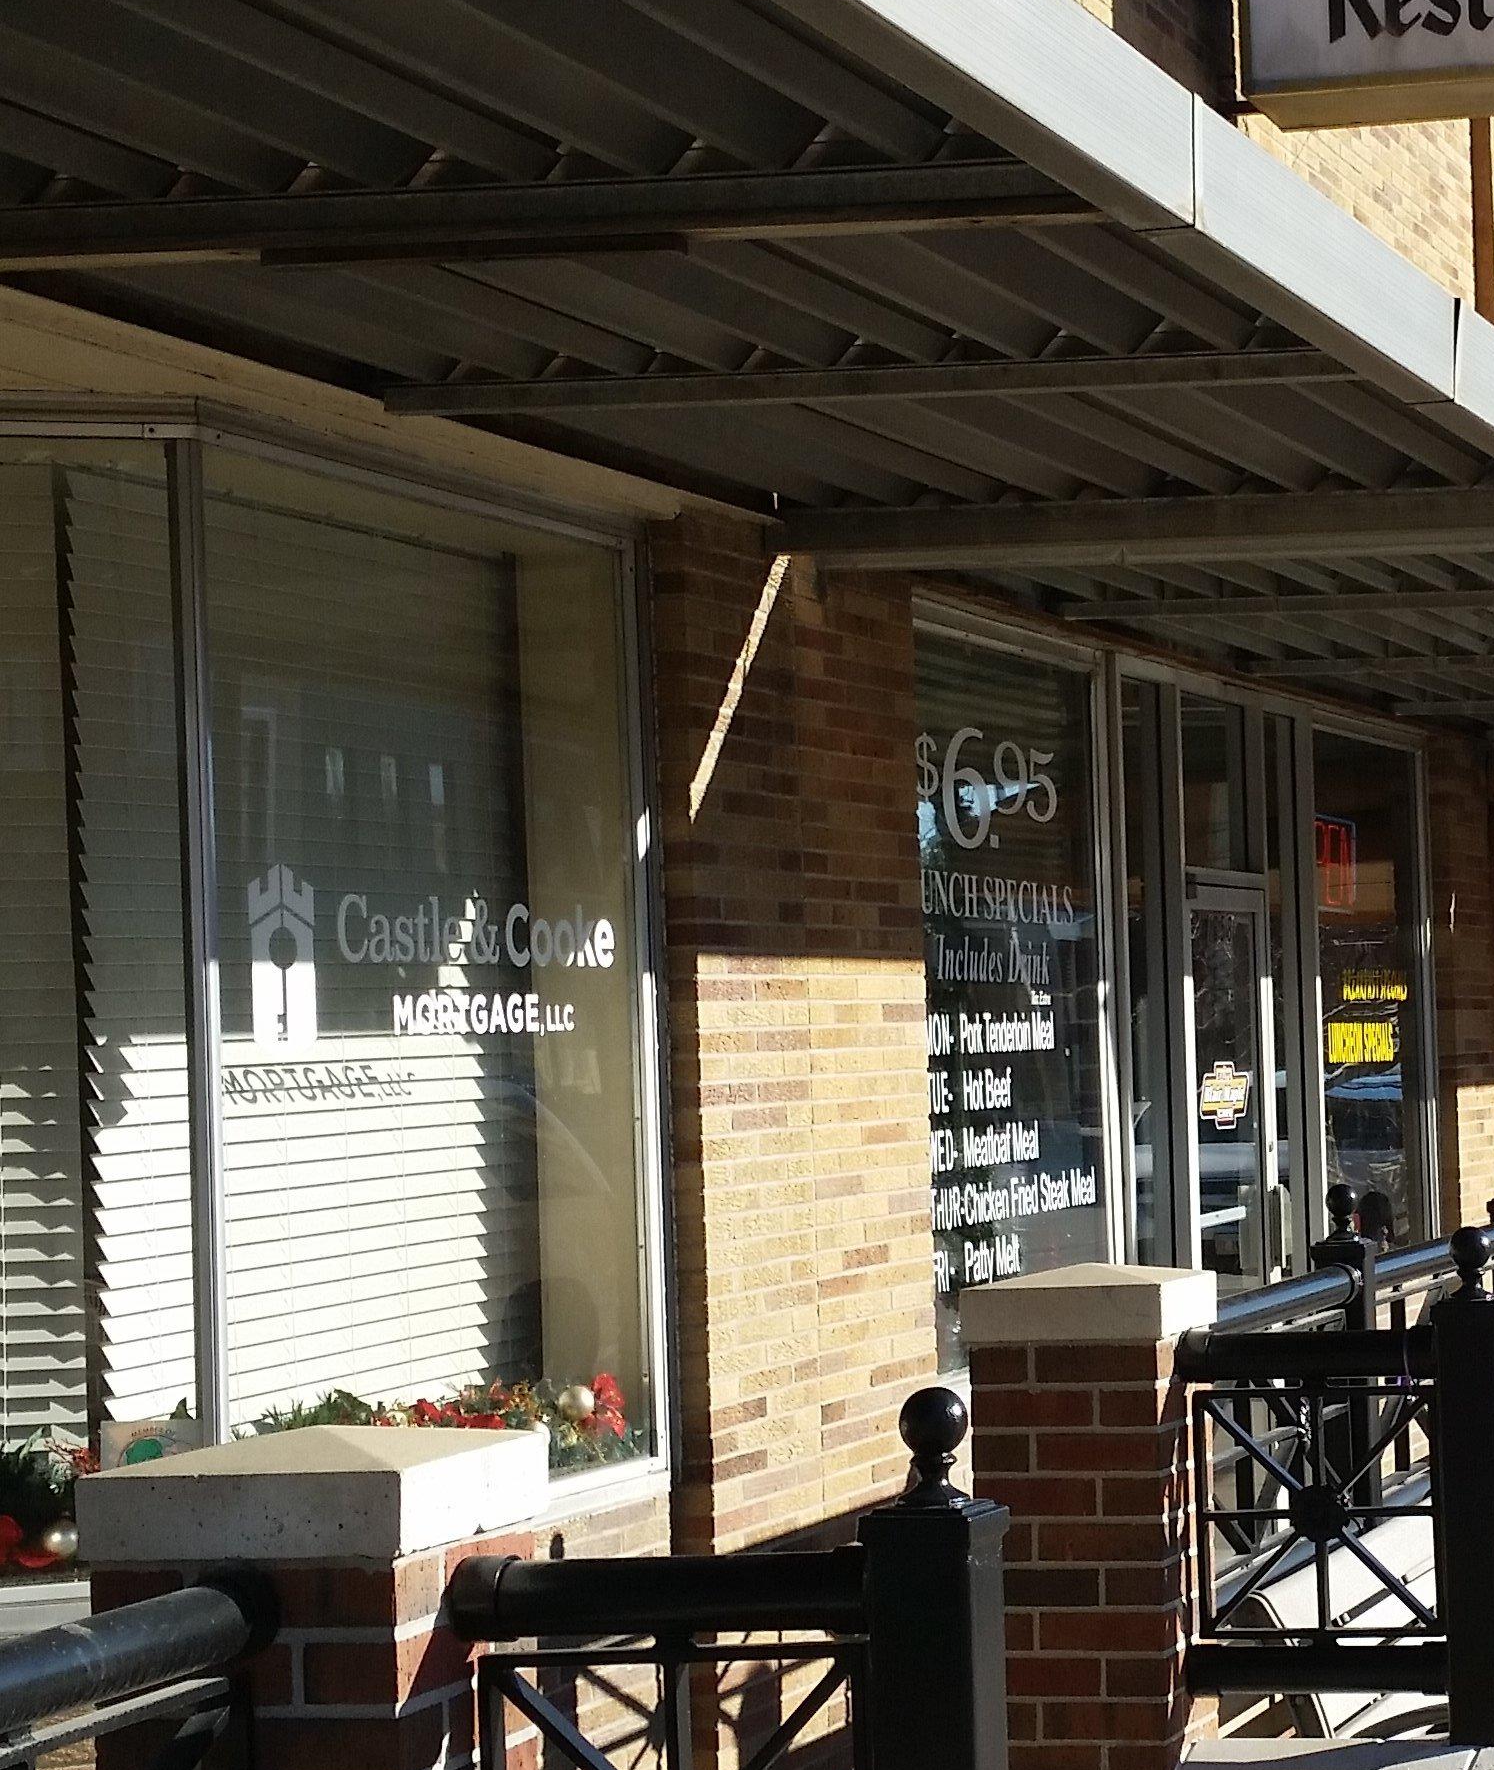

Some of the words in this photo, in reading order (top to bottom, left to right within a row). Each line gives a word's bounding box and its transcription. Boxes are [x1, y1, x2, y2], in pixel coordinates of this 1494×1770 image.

[915, 727, 1058, 850] $6.95
[920, 868, 979, 919] UNCH
[983, 875, 1075, 926] SPECIALS
[337, 893, 464, 964] Castle
[469, 898, 500, 965] &
[505, 902, 616, 969] Cooke
[937, 934, 1003, 983] Includes
[1008, 937, 1051, 986] Drink
[545, 1003, 575, 1032] LLC
[959, 1012, 984, 1054] Pork
[983, 1011, 1031, 1054] Tenderloin
[1031, 1010, 1055, 1051] Meal
[962, 1068, 984, 1112] Hot
[984, 1065, 1012, 1110] Beef
[962, 1121, 1011, 1169] Meatloaf
[1012, 1118, 1040, 1162] Meal
[964, 1180, 1009, 1226] Chicken
[1010, 1174, 1039, 1218] Fried
[1039, 1170, 1070, 1213] Steak
[1070, 1165, 1097, 1207] Meal
[963, 1241, 995, 1285] Patty
[995, 1232, 1021, 1276] Melt
